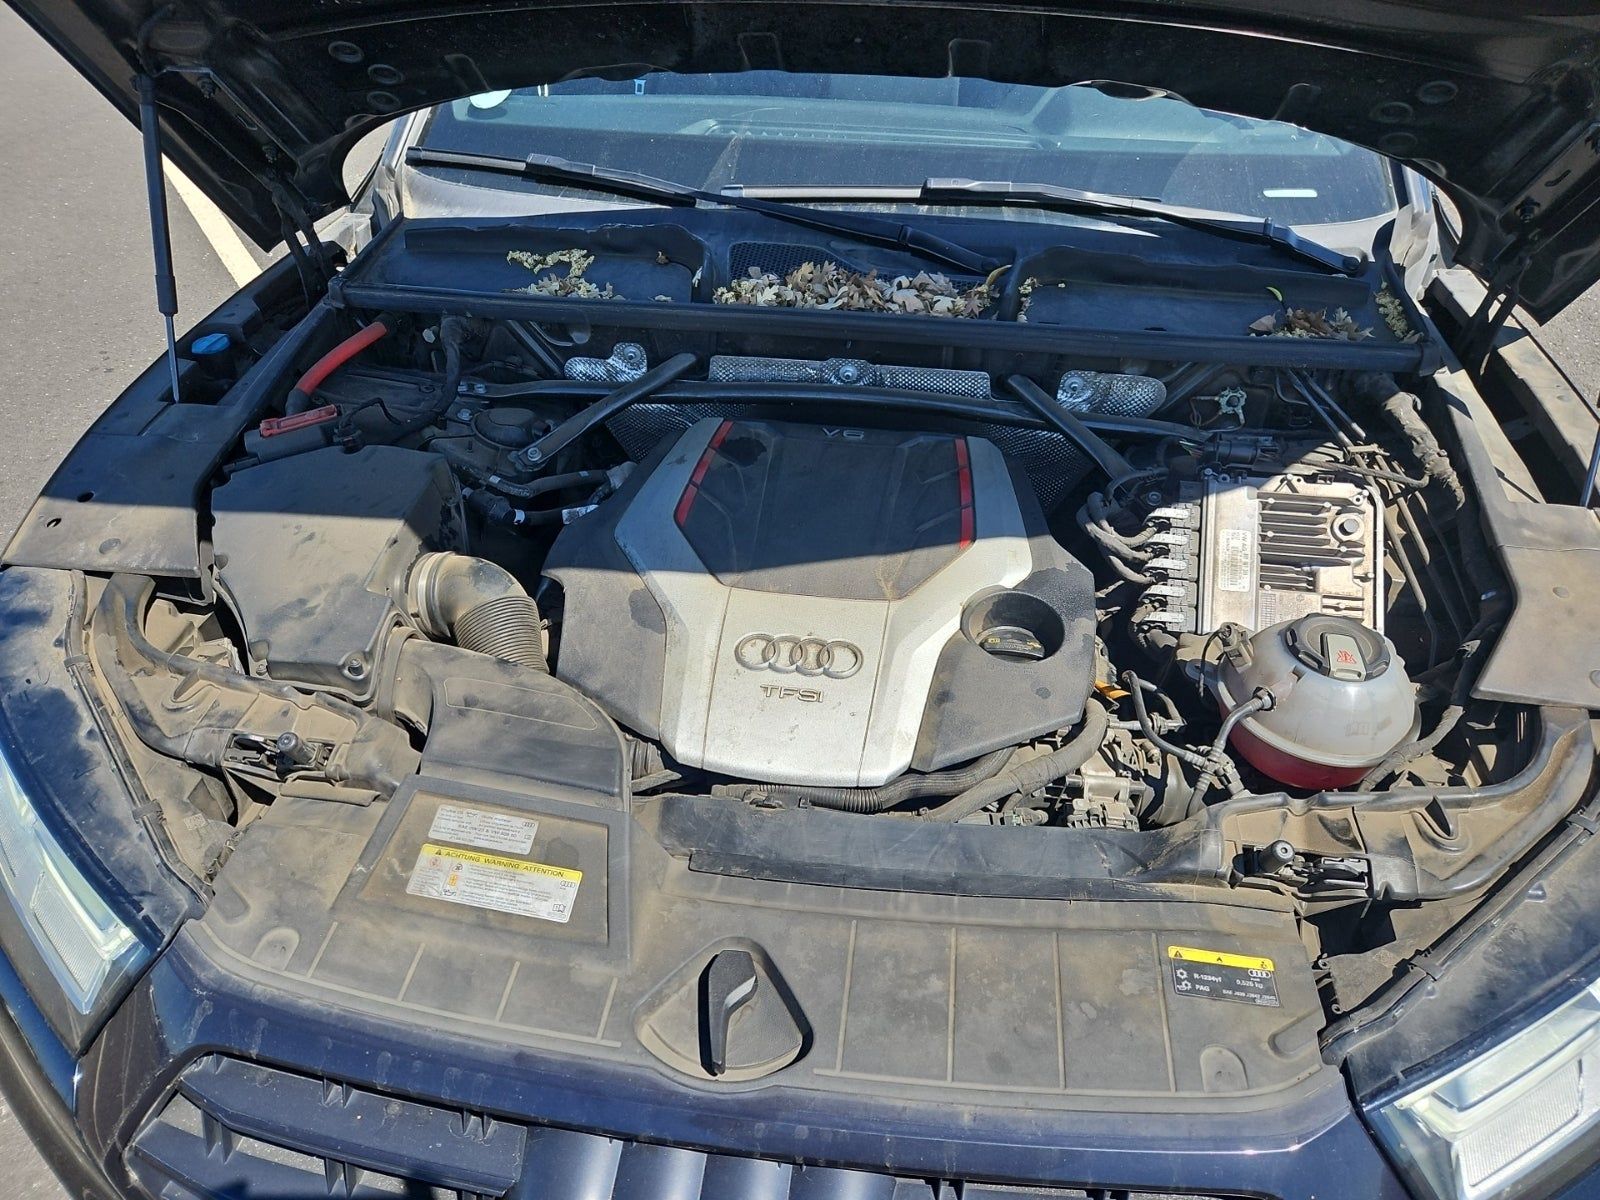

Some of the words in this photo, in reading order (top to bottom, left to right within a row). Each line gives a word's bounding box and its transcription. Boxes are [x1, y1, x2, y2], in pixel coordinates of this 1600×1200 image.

[822, 427, 865, 440] V6
[760, 684, 824, 703] TFSI
[444, 851, 481, 863] ACHTUNG
[484, 858, 521, 870] WARNING
[523, 865, 565, 878] ATTENTION
[1193, 973, 1222, 983] R-1234yf
[1195, 984, 1210, 992] PAG
